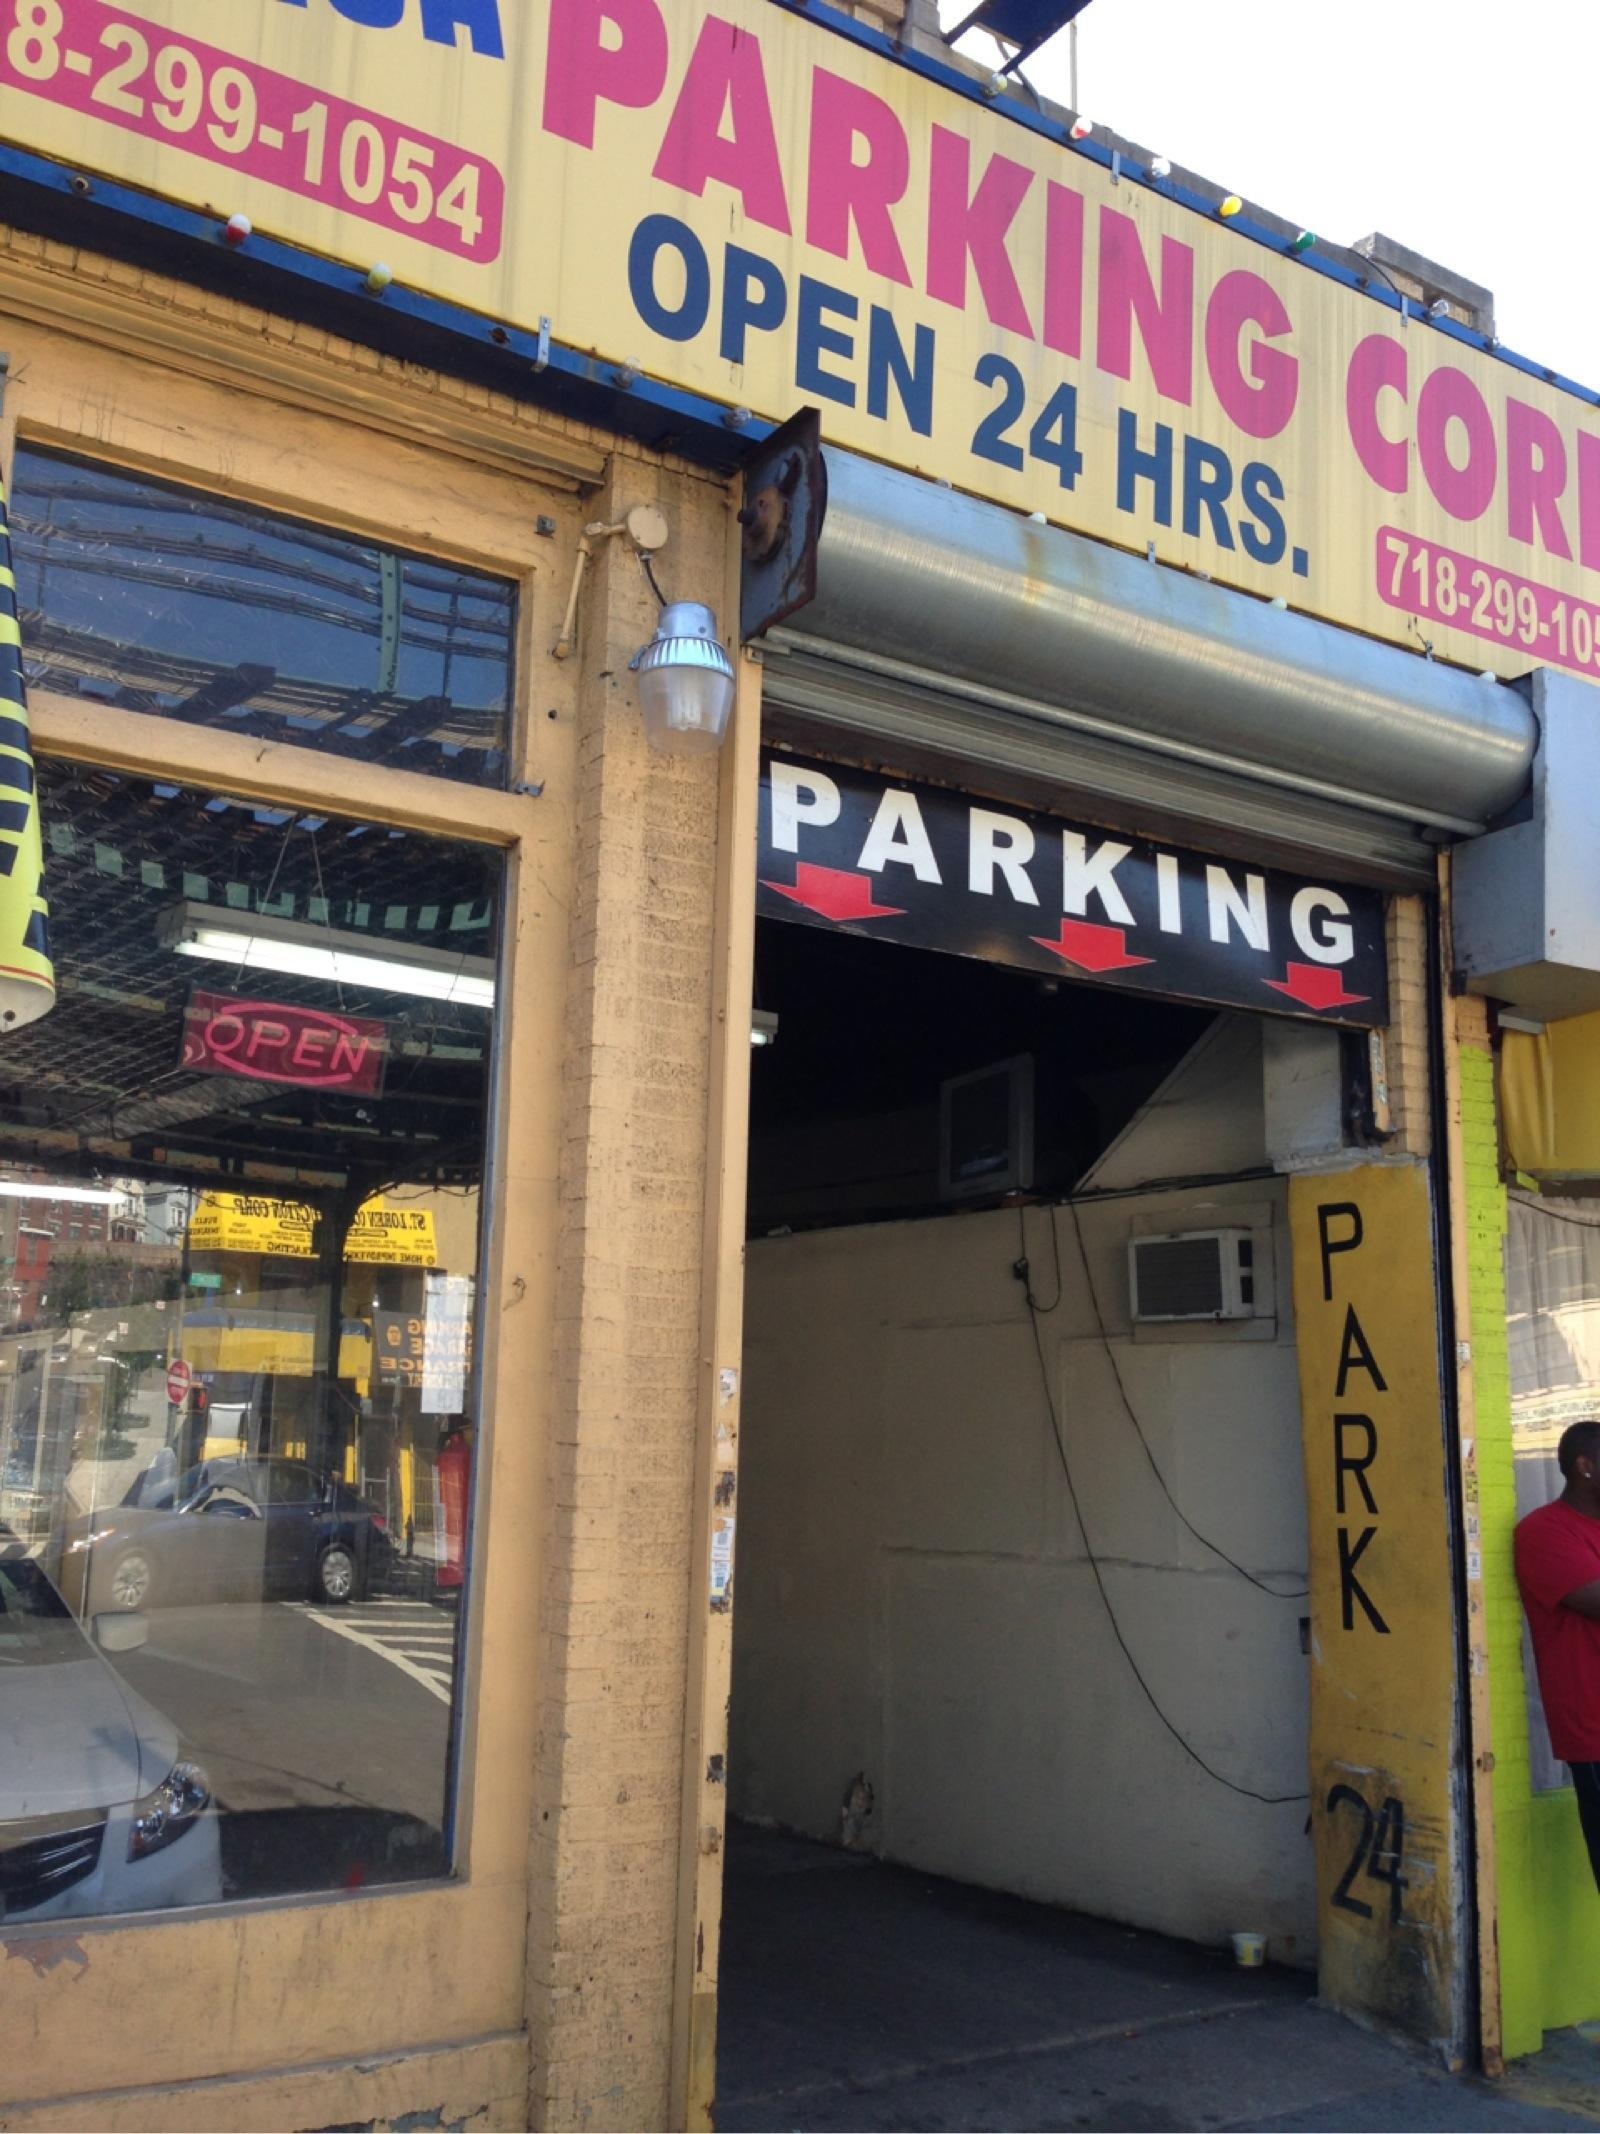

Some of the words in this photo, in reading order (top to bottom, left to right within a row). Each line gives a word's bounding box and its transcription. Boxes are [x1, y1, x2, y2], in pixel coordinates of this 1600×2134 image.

[542, 0, 1298, 438] PARKING
[628, 213, 935, 438] OPEN
[971, 352, 1083, 492] 24
[1117, 407, 1309, 578] HRS.
[1385, 537, 1600, 668] 718-299-10
[769, 760, 1354, 965] PARKING
[204, 1014, 369, 1073] OPEN
[1317, 1202, 1391, 1634] PARK
[1327, 1784, 1410, 1924] 24
